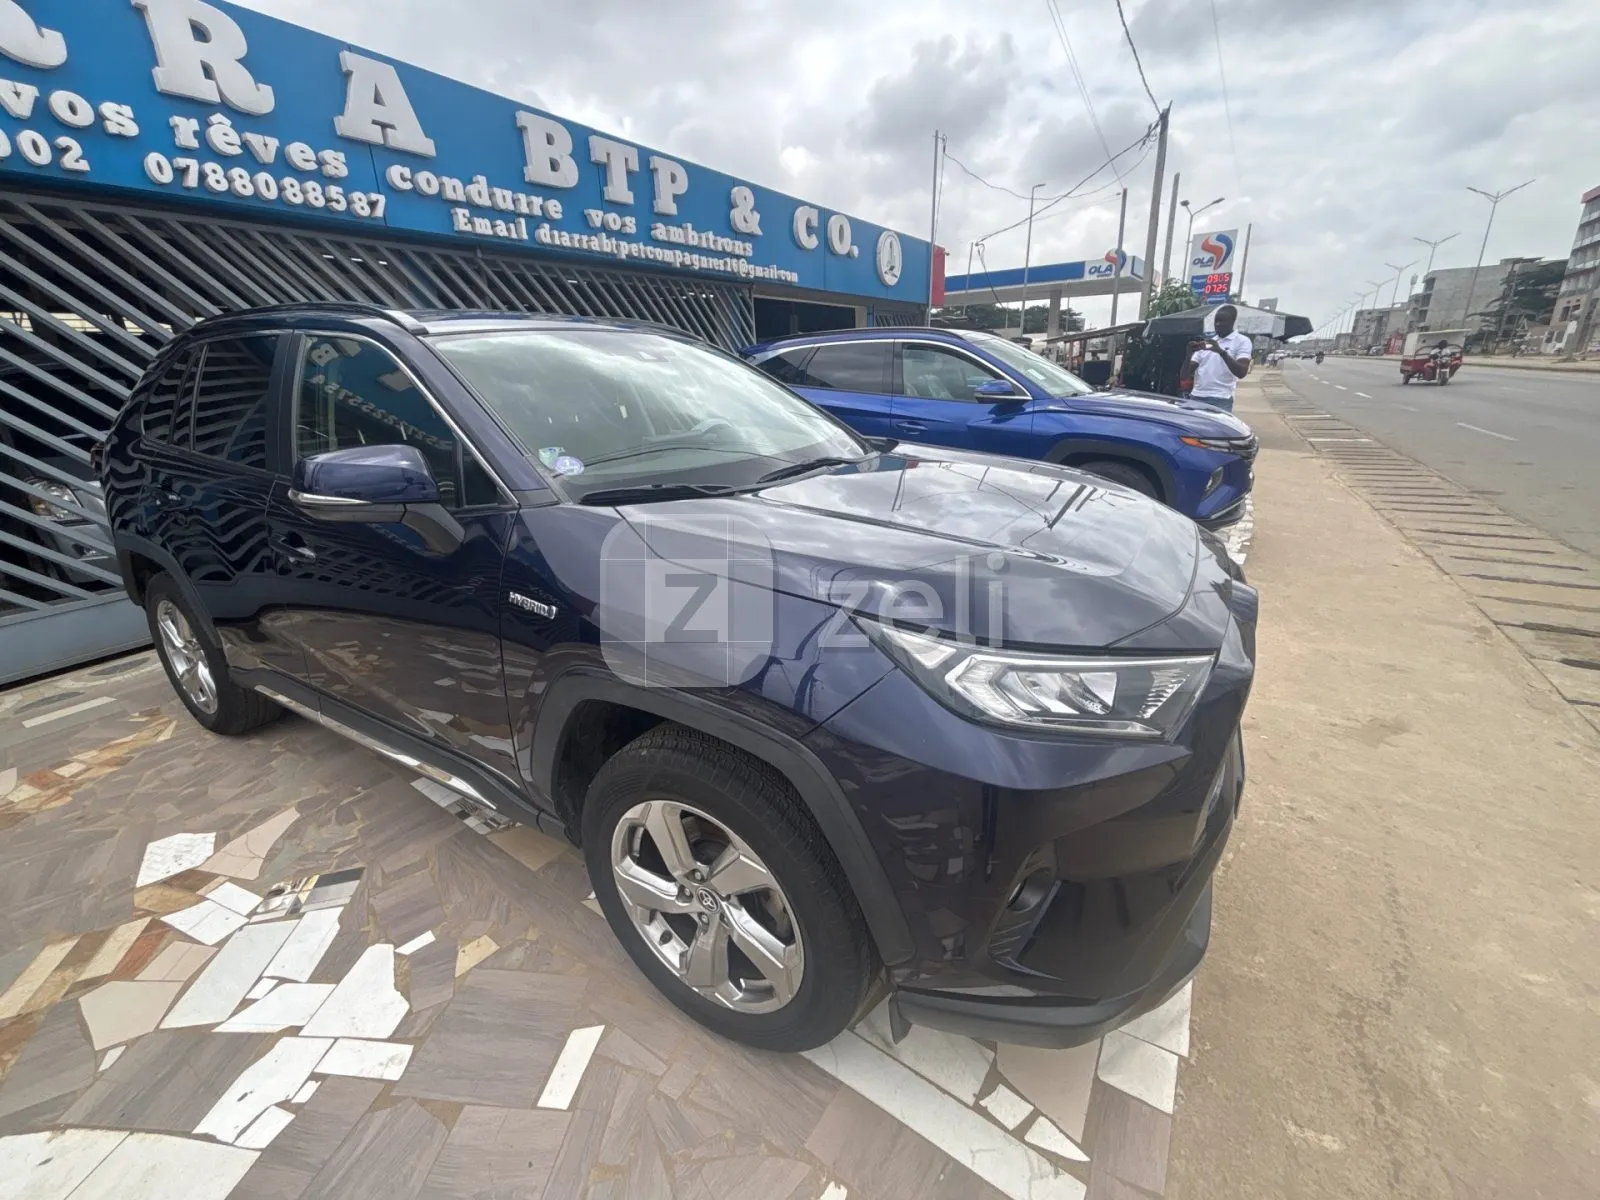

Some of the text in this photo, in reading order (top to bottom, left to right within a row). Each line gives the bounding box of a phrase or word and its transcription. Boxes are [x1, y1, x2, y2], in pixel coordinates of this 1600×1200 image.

[0, 78, 140, 138] vos
[169, 112, 350, 180] rêves
[584, 208, 637, 235] vos
[143, 151, 387, 219] 0788088587
[450, 207, 529, 241] Email
[515, 110, 688, 216] BTP
[730, 186, 763, 236] &
[793, 205, 859, 259] CO.
[1088, 262, 1113, 275] OLA
[1192, 256, 1215, 266] OLA
